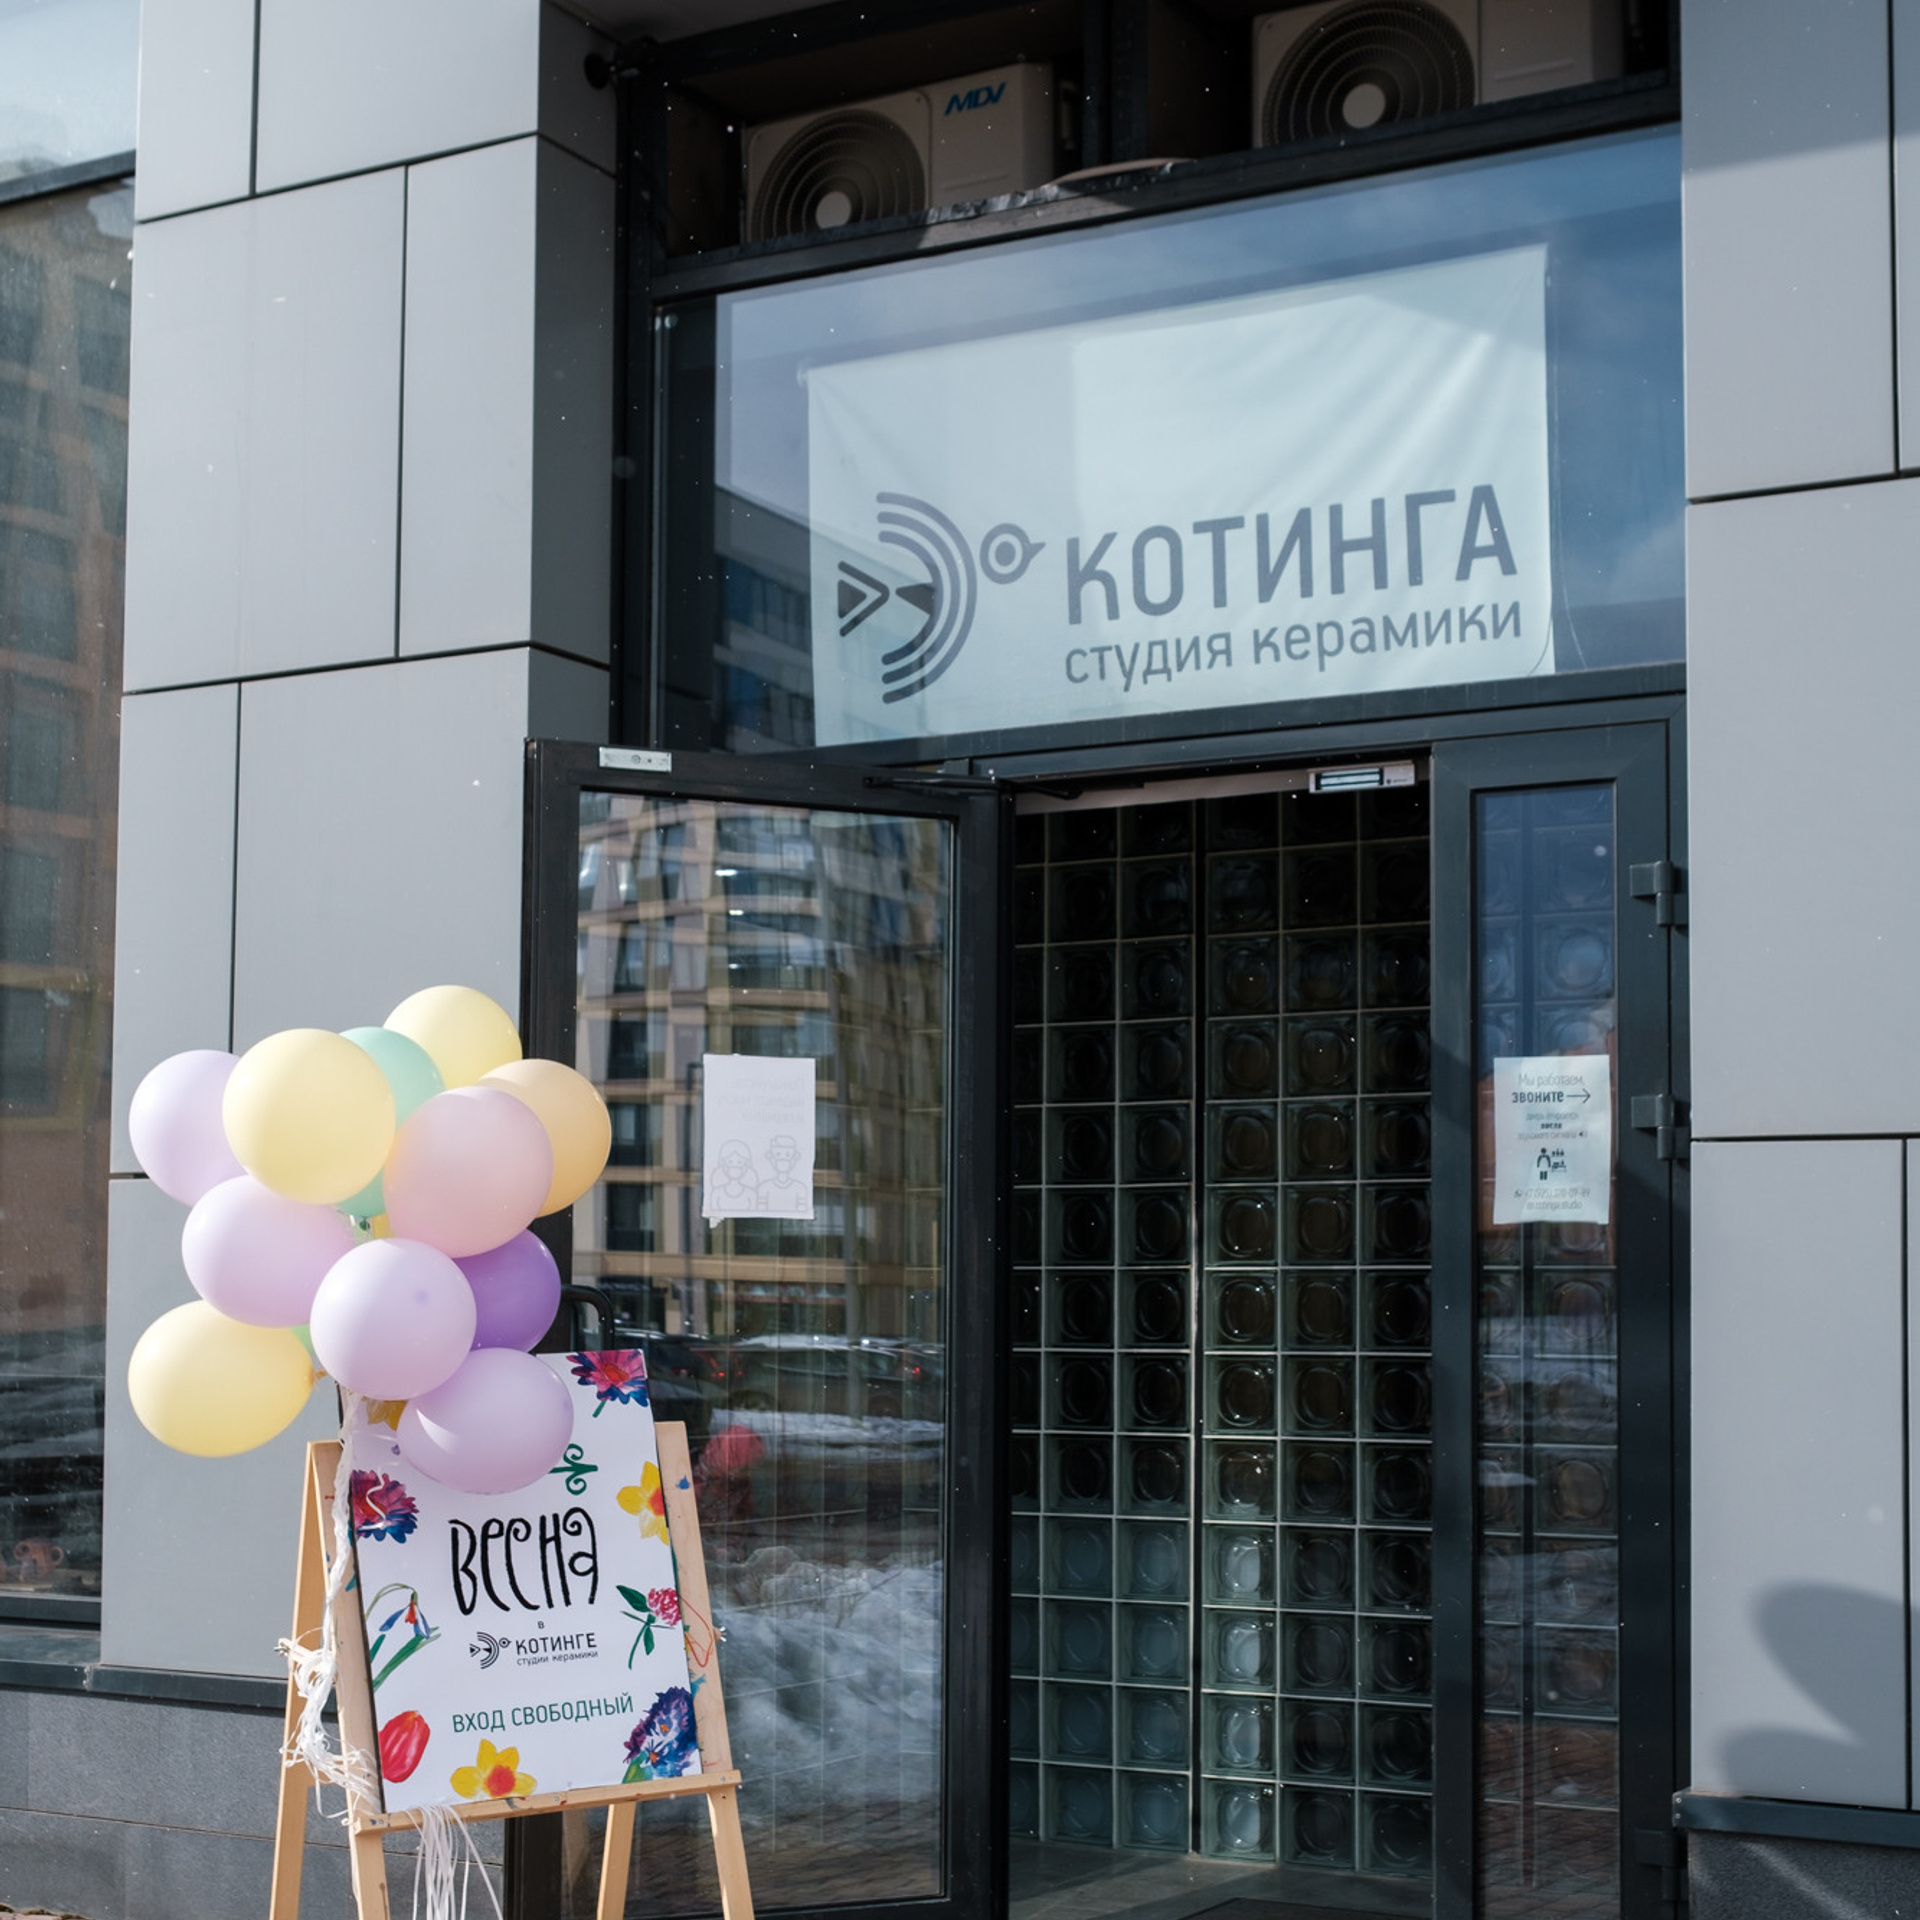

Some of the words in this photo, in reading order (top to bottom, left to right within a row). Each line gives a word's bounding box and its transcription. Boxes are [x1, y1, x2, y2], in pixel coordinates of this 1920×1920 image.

[944, 82, 1006, 116] MDV
[1066, 484, 1517, 625] КОТИНГА
[1065, 632, 1233, 692] студия
[1253, 601, 1522, 672] керамики
[1518, 1072, 1535, 1086] Мы
[537, 1620, 545, 1629] в
[515, 1632, 597, 1656] КОТИНГЕ
[516, 1656, 549, 1667] студии
[552, 1651, 598, 1663] керамики
[452, 1709, 506, 1733] ВХОД
[511, 1692, 634, 1727] СВОБОДНЫЙ
